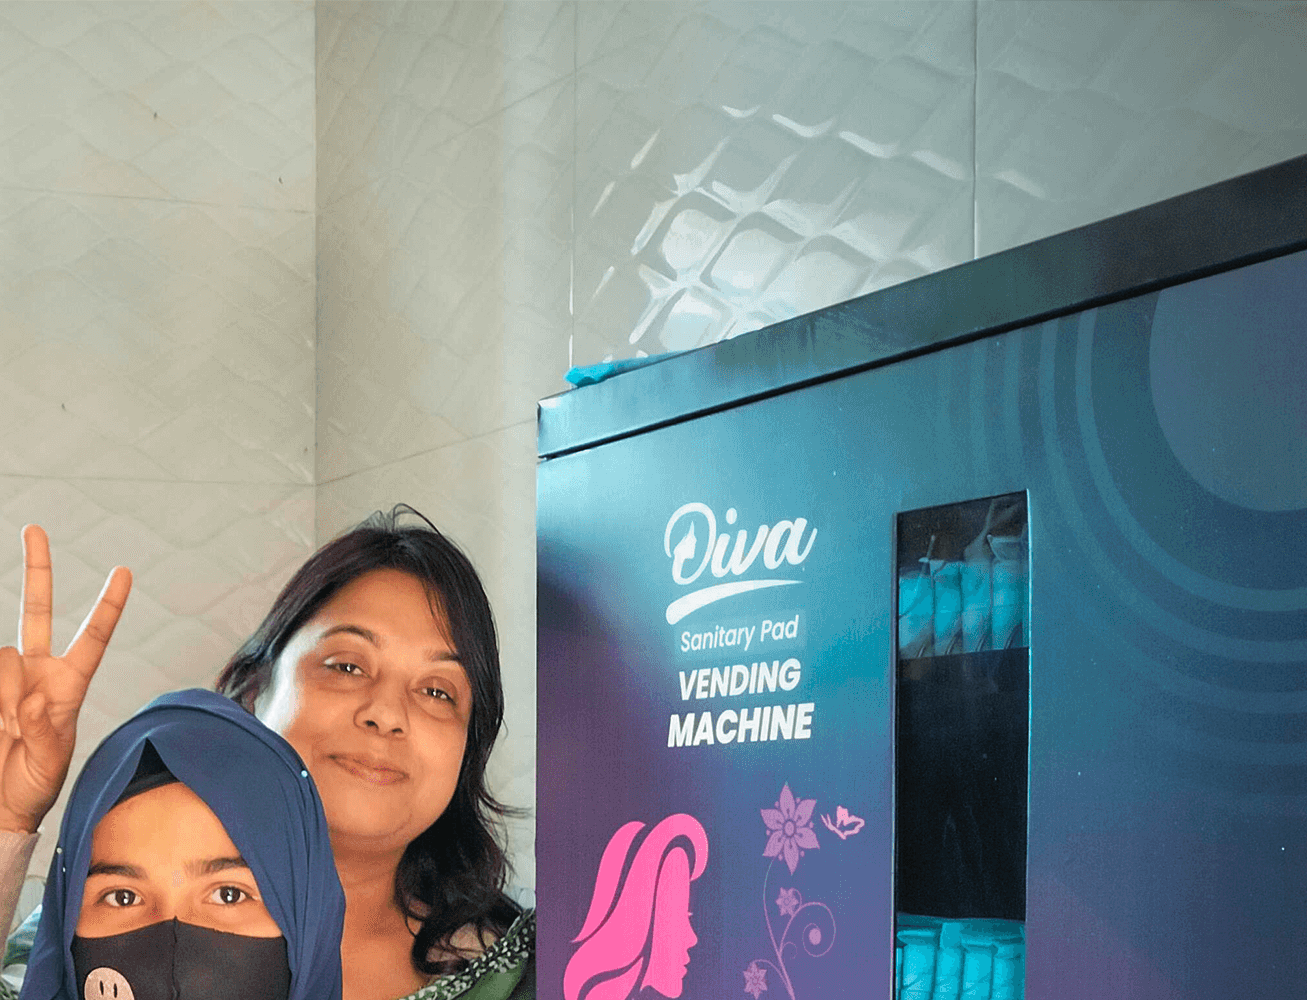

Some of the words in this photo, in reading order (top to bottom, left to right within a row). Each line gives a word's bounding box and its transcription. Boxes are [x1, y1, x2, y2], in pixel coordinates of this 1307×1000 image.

[664, 502, 817, 585] Diva
[680, 625, 755, 651] Sanitary
[760, 615, 799, 642] Pad
[679, 659, 801, 701] VENDING
[667, 703, 815, 748] MACHINE
